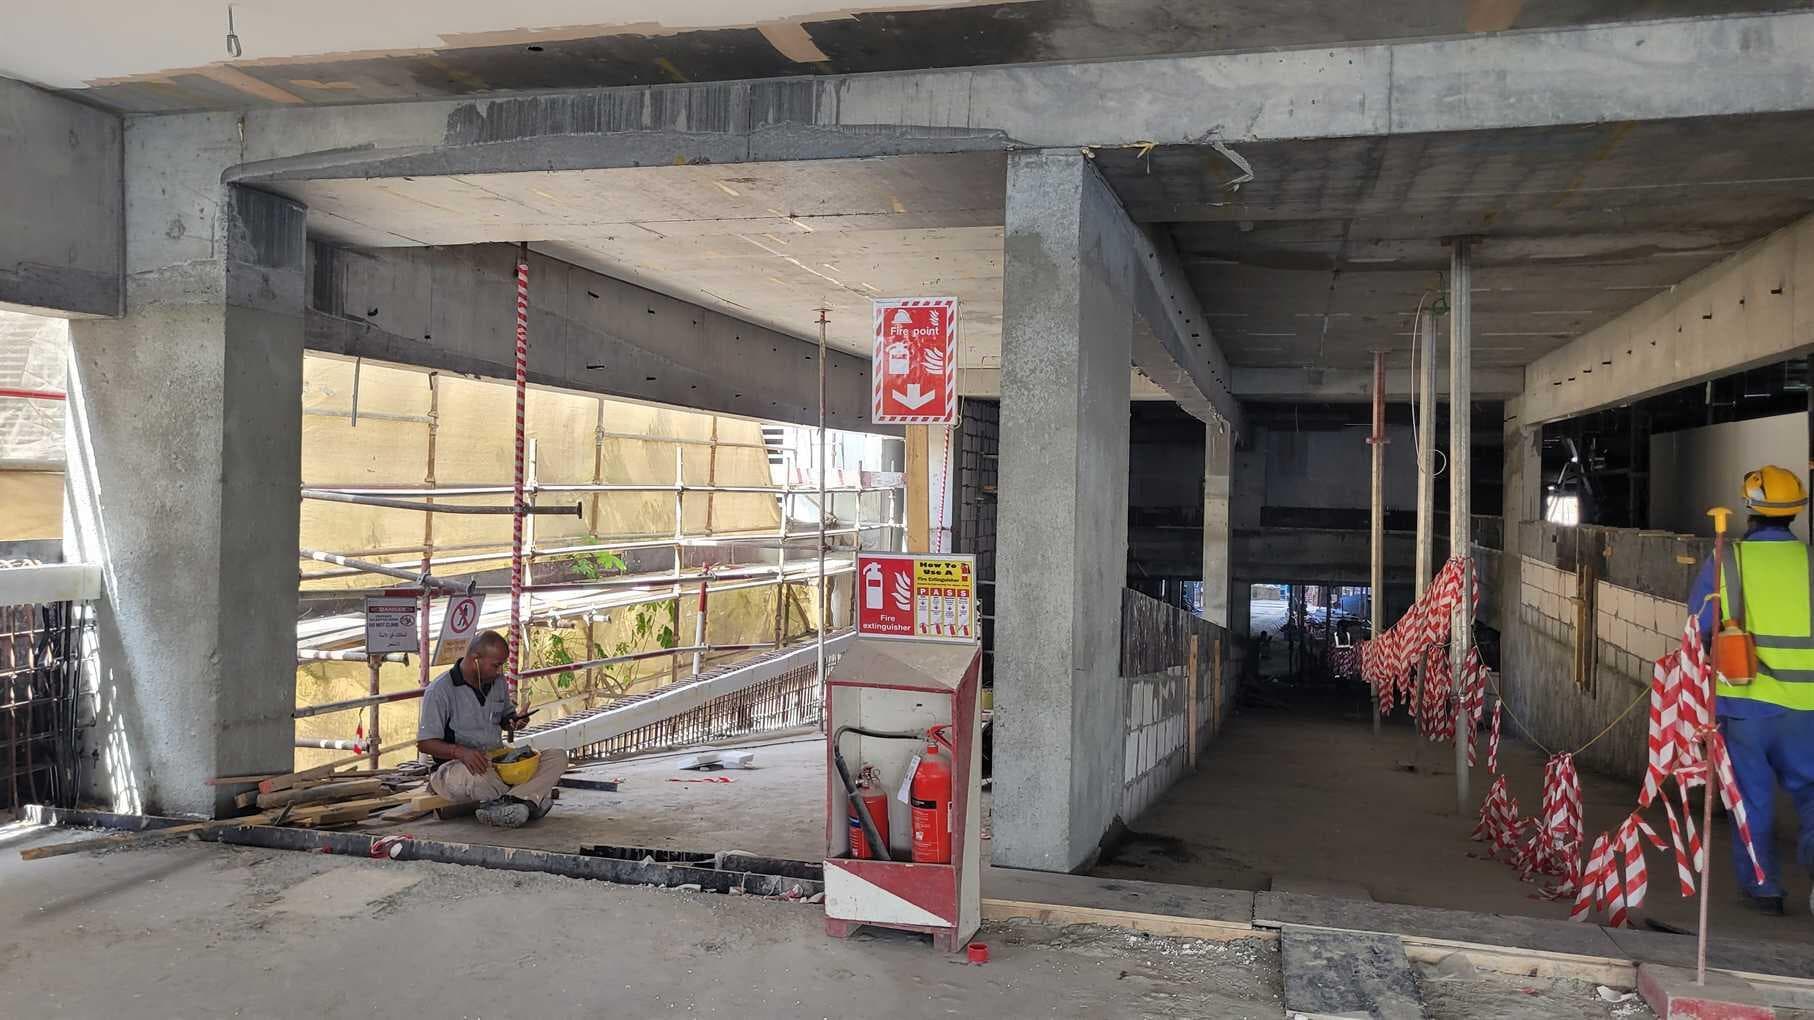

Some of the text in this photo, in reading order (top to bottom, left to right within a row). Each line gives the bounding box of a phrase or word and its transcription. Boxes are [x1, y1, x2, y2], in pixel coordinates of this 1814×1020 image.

[890, 326, 940, 338] Fire point
[933, 588, 940, 596] A
[880, 614, 896, 622] Fire
[862, 622, 912, 632] extinguisher
